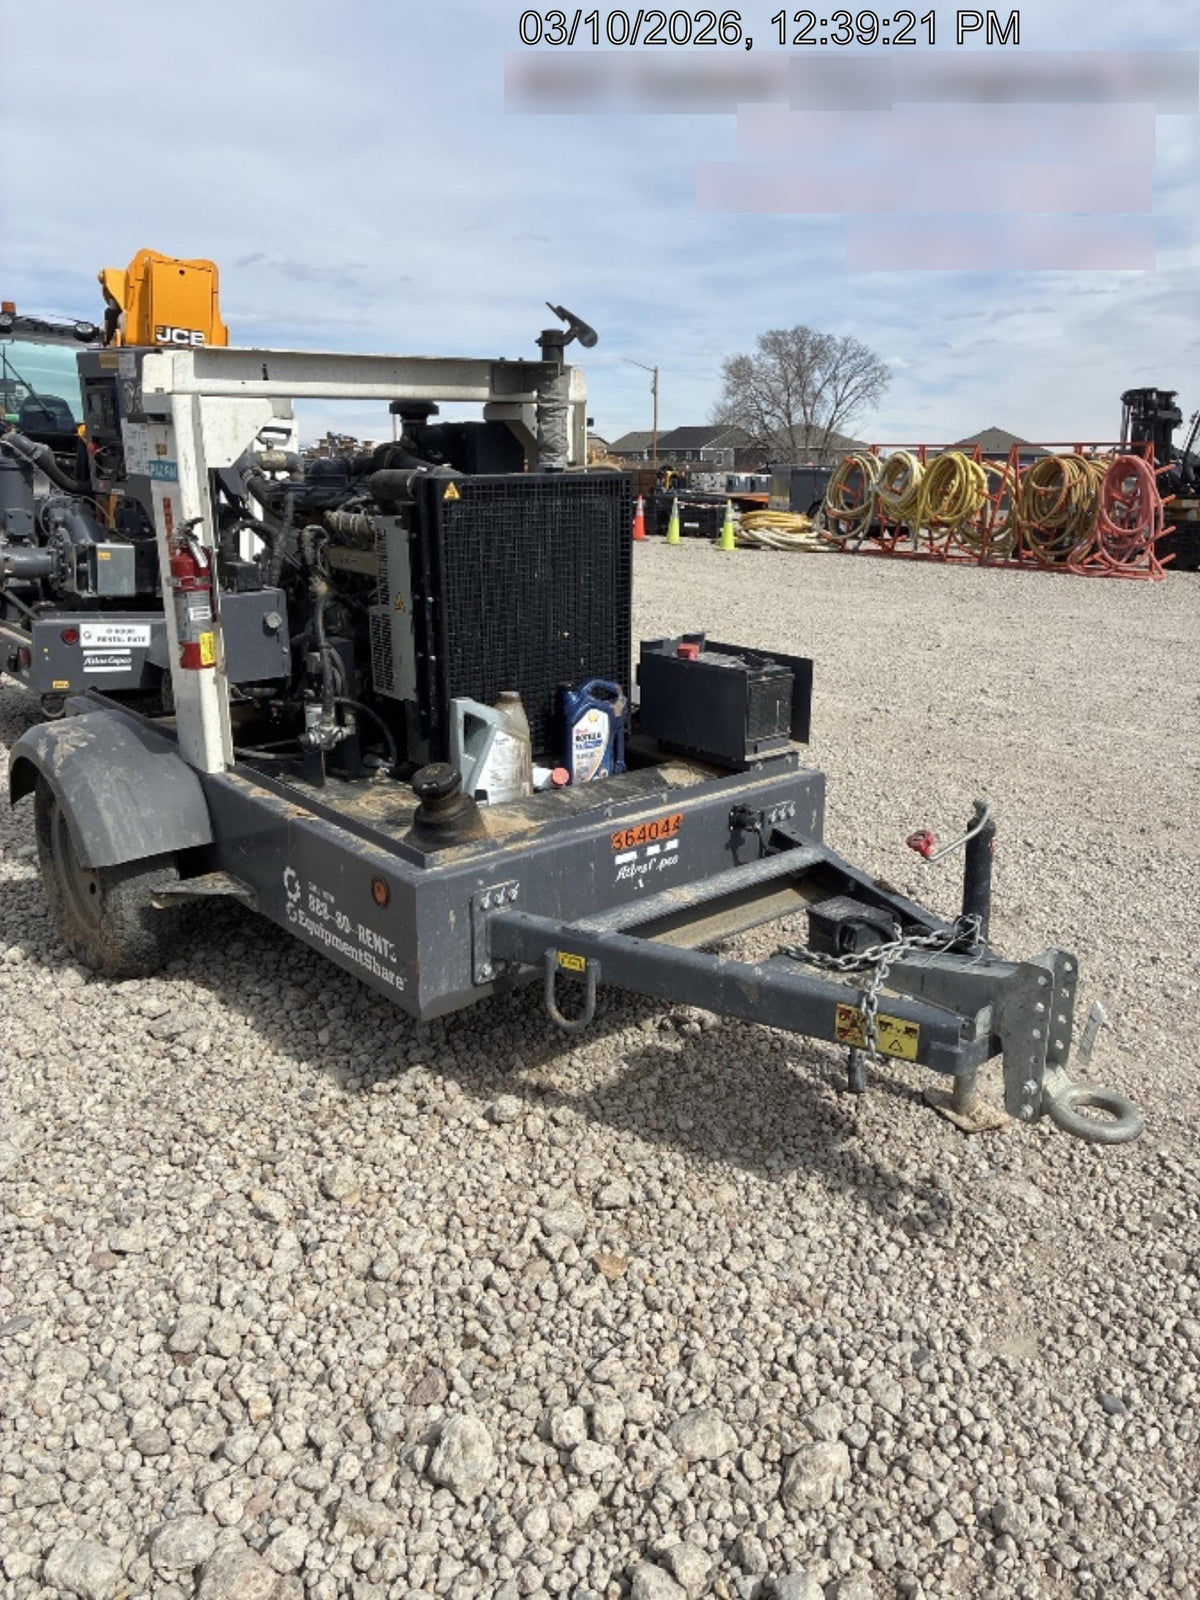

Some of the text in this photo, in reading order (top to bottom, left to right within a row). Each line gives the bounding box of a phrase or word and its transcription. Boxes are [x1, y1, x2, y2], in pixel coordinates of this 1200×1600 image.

[155, 326, 206, 346] JCB
[612, 815, 680, 851] 364044
[297, 907, 405, 991] EquipmentShare
